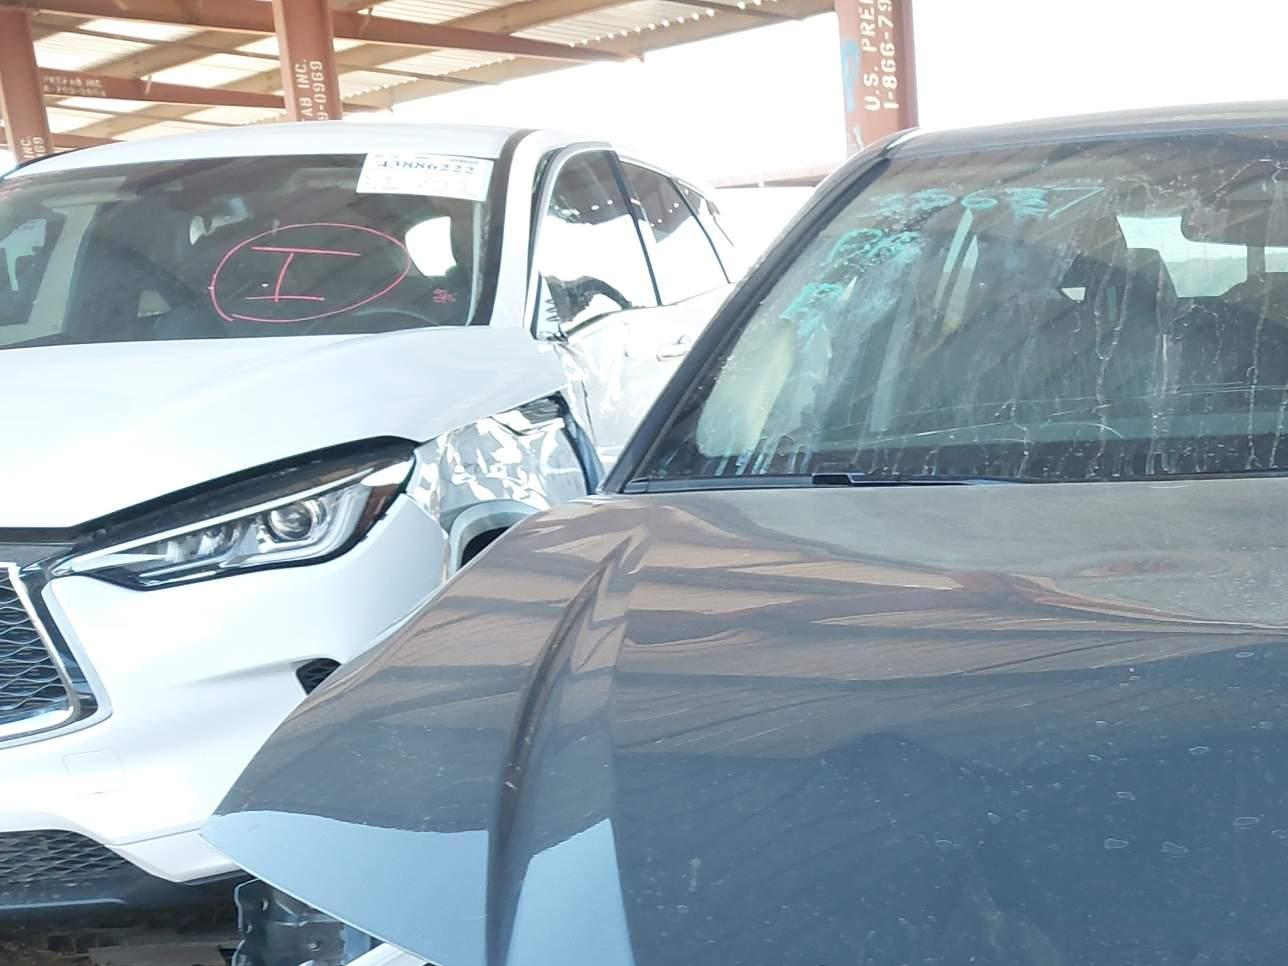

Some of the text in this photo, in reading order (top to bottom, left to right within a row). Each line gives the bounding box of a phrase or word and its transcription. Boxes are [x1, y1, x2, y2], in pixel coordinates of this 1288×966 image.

[859, 0, 881, 111] U.S. PRE
[295, 59, 314, 121] AB INC.
[376, 159, 475, 176] 43886222
